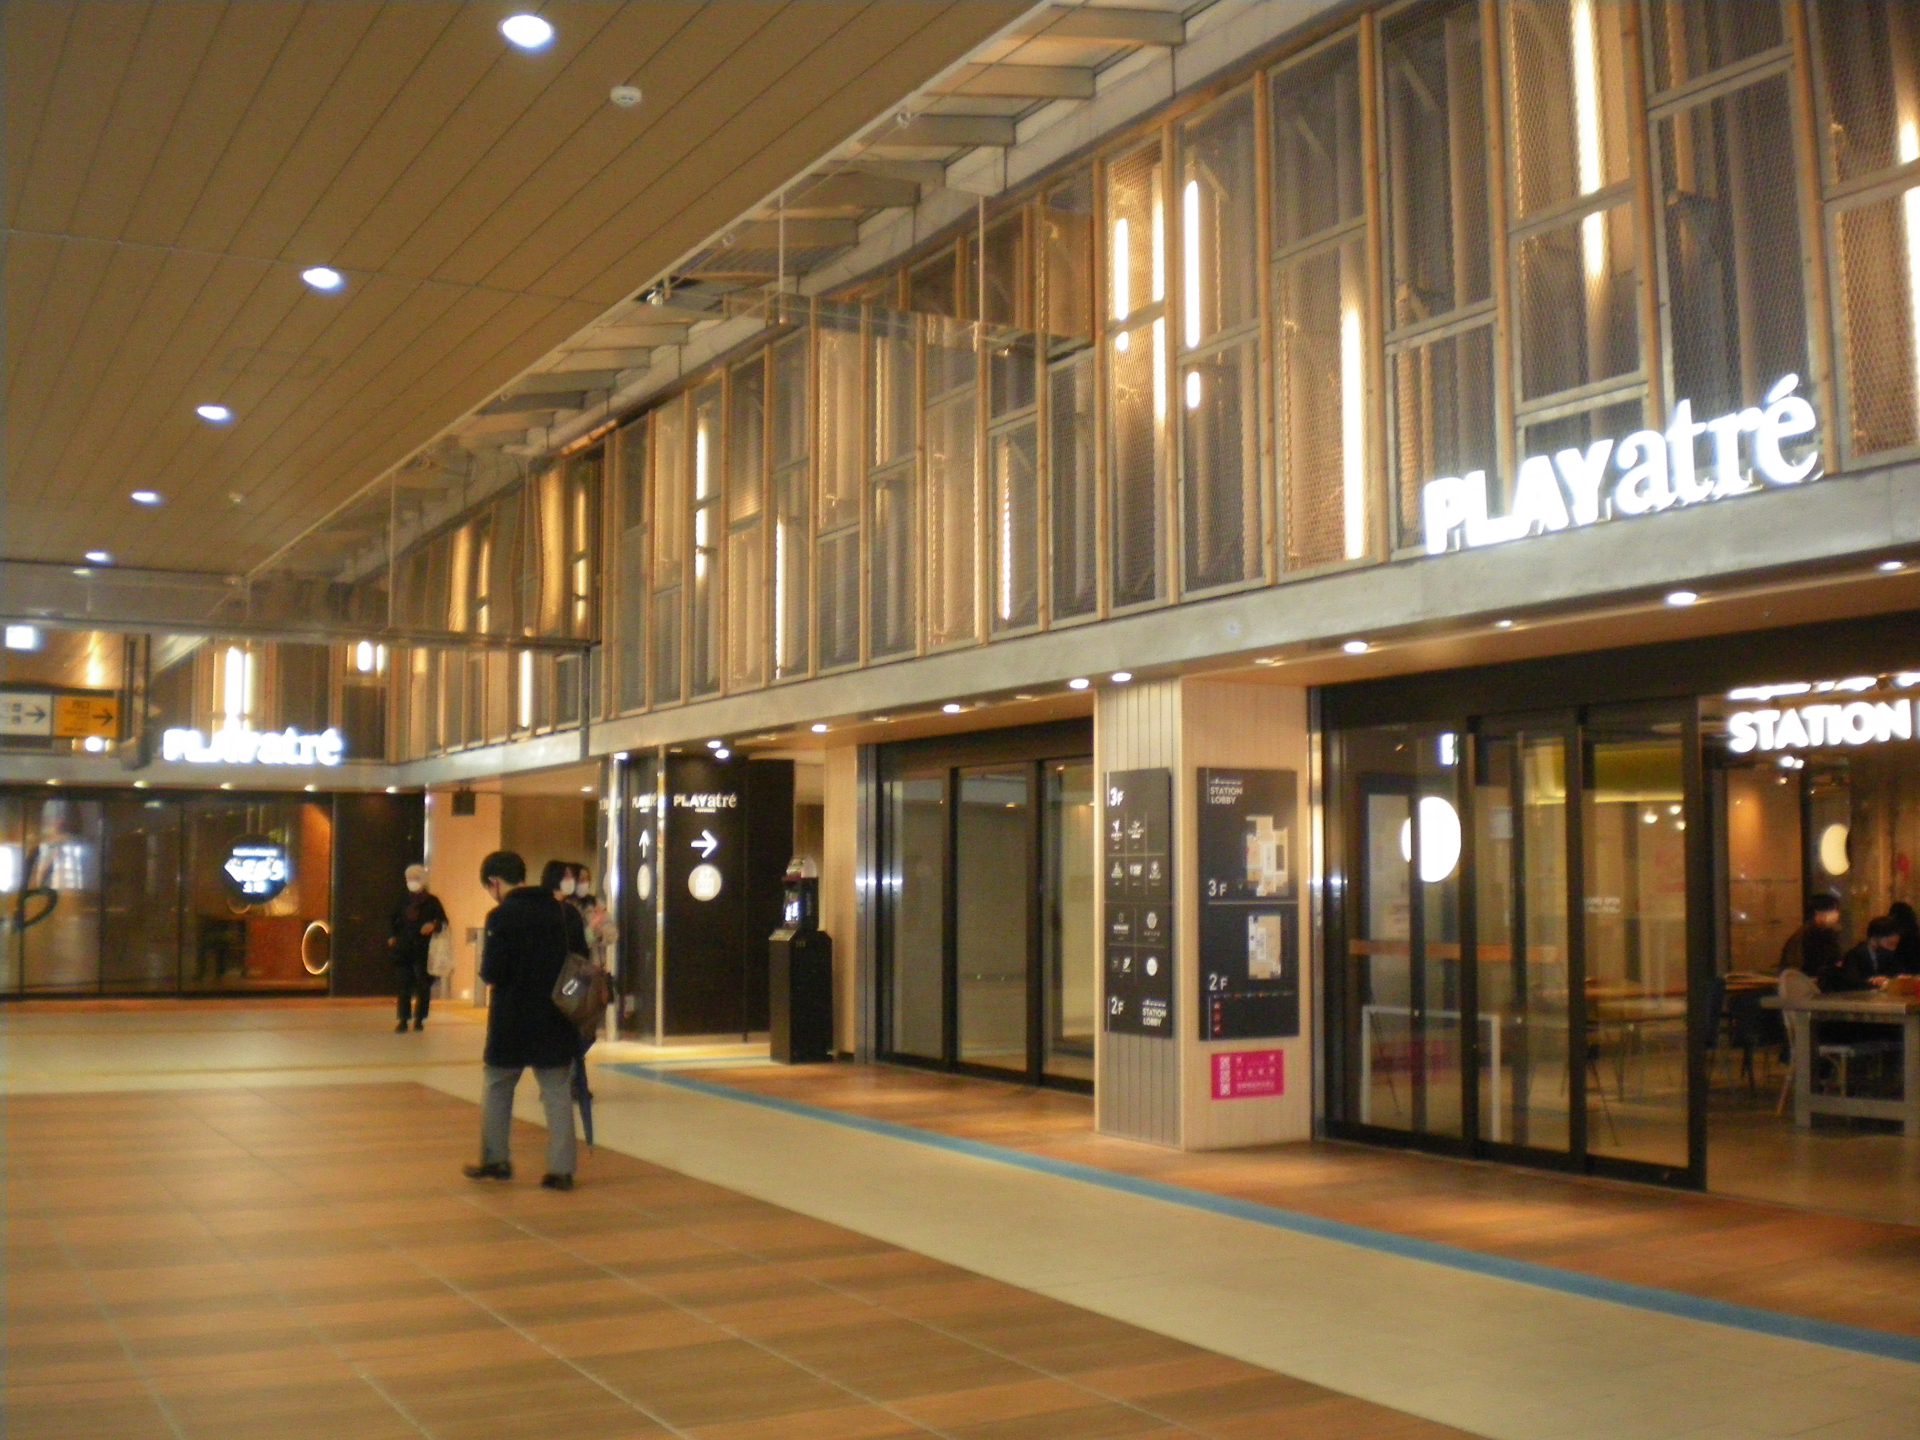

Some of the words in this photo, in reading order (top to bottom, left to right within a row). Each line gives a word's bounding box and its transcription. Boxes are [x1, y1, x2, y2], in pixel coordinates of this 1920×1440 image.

[1422, 373, 1818, 554] PLAYatré
[1728, 698, 1912, 753] STATION
[673, 791, 738, 808] PLAYatré
[1109, 786, 1125, 807] 3F
[1210, 786, 1244, 796] STATION
[1211, 796, 1237, 805] LOBBY
[1208, 973, 1228, 991] 2F
[1111, 996, 1125, 1015] 2F
[1142, 1007, 1167, 1018] STATION
